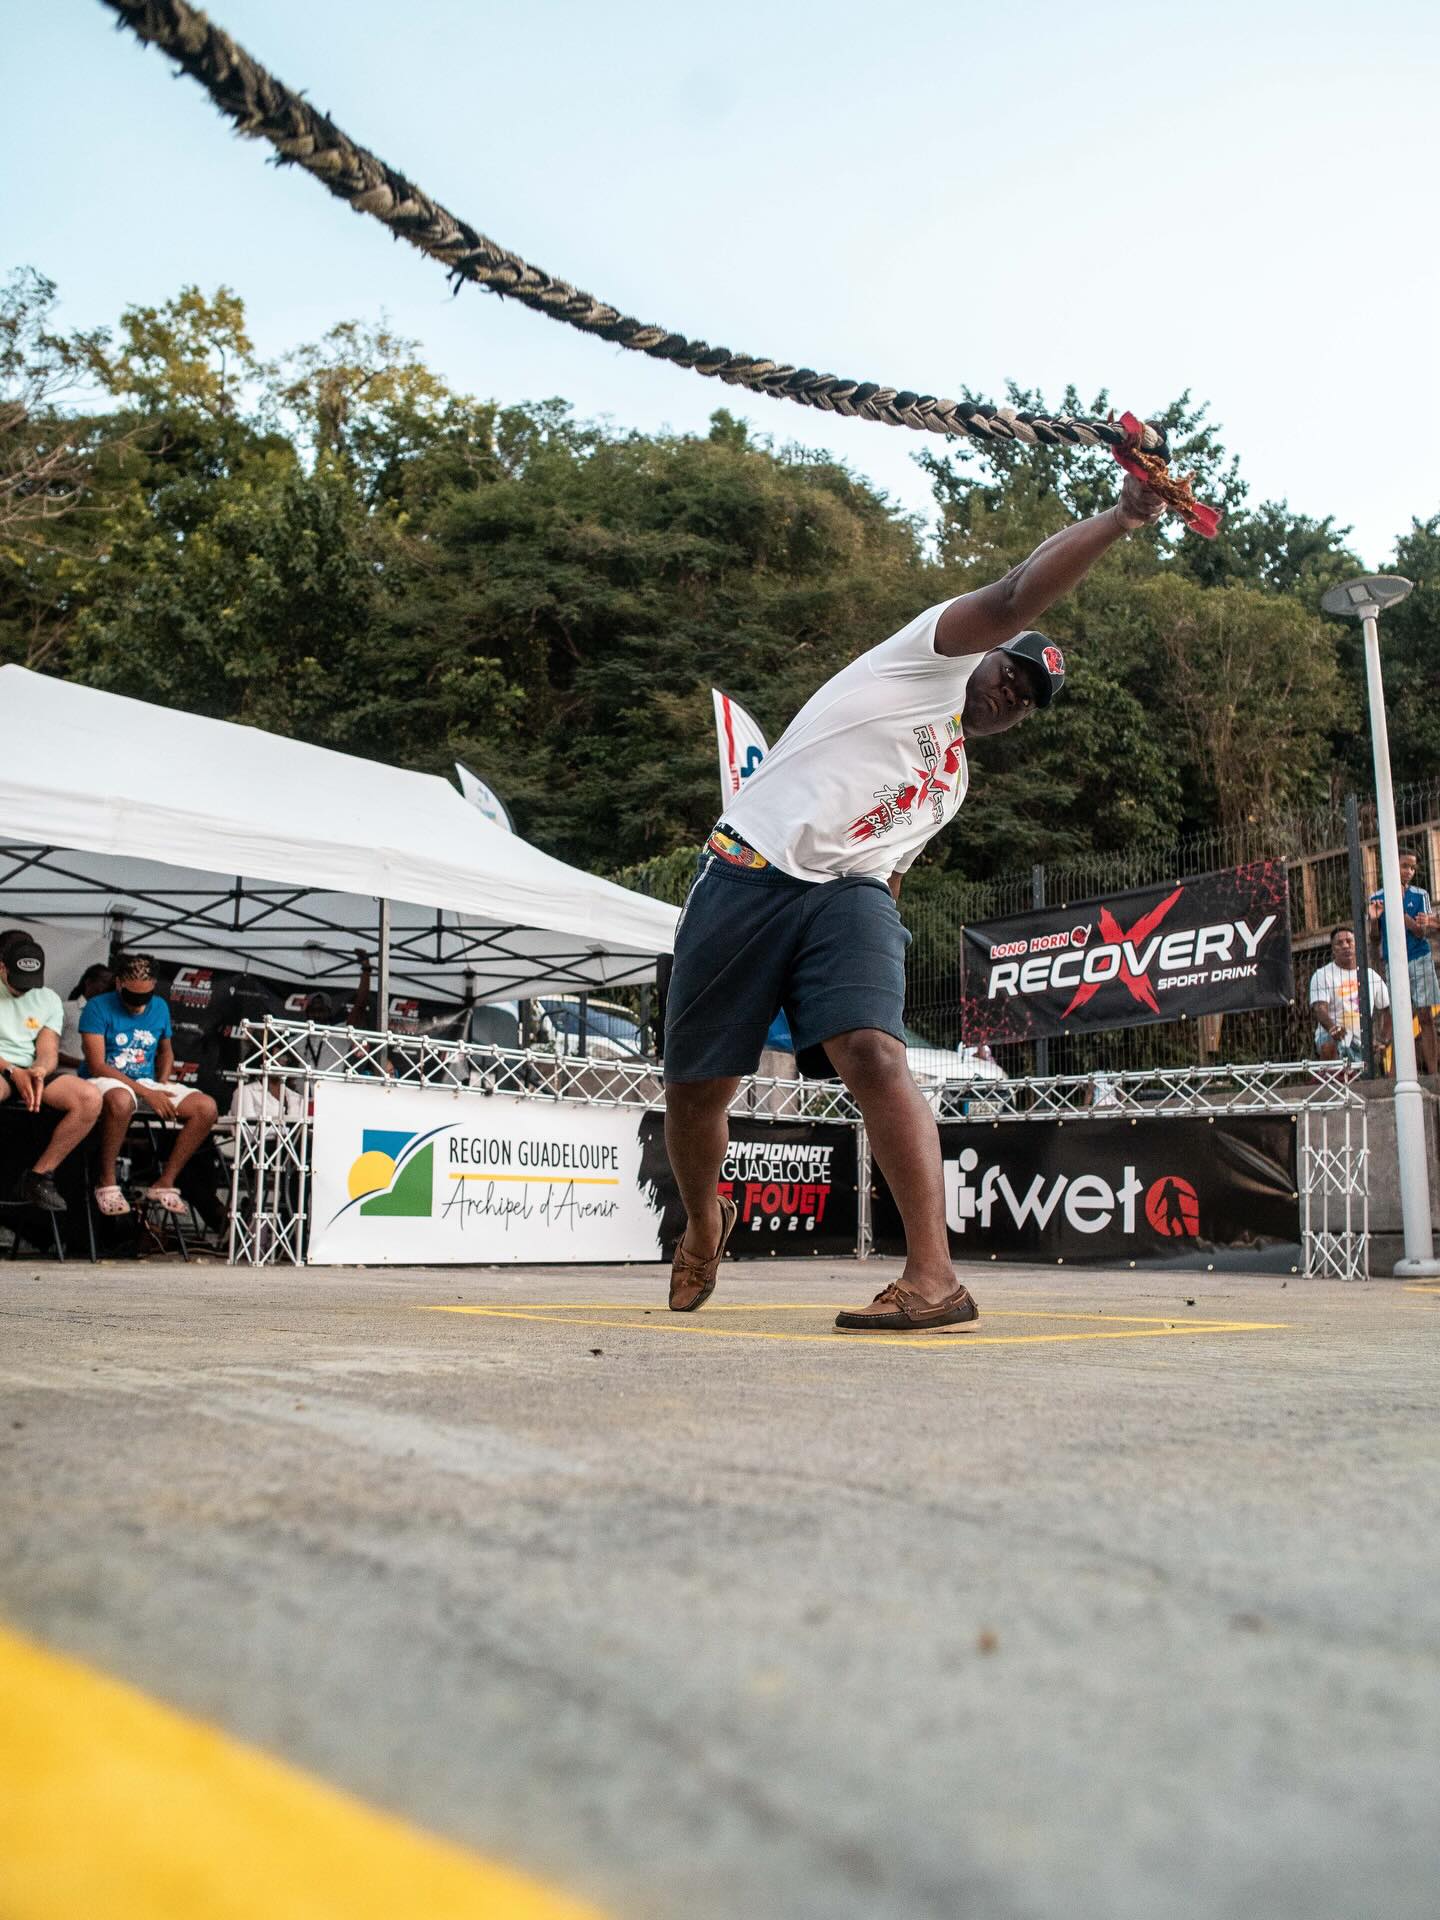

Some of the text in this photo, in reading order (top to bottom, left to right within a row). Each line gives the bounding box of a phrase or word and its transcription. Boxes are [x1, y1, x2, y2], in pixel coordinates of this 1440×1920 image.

[863, 813, 886, 839] BAL
[988, 915, 1277, 999] RECOVERY
[990, 931, 1069, 959] LONG HORN
[1157, 964, 1257, 990] SPORT DRINK
[449, 1137, 619, 1170] REGION GUADELOUPE
[725, 1141, 834, 1162] AMPIONNAT
[721, 1159, 832, 1183] GUADELOUPE
[442, 1175, 620, 1231] Archipel d'Avenir
[743, 1183, 831, 1223] FOUET
[751, 1216, 816, 1231] 2026
